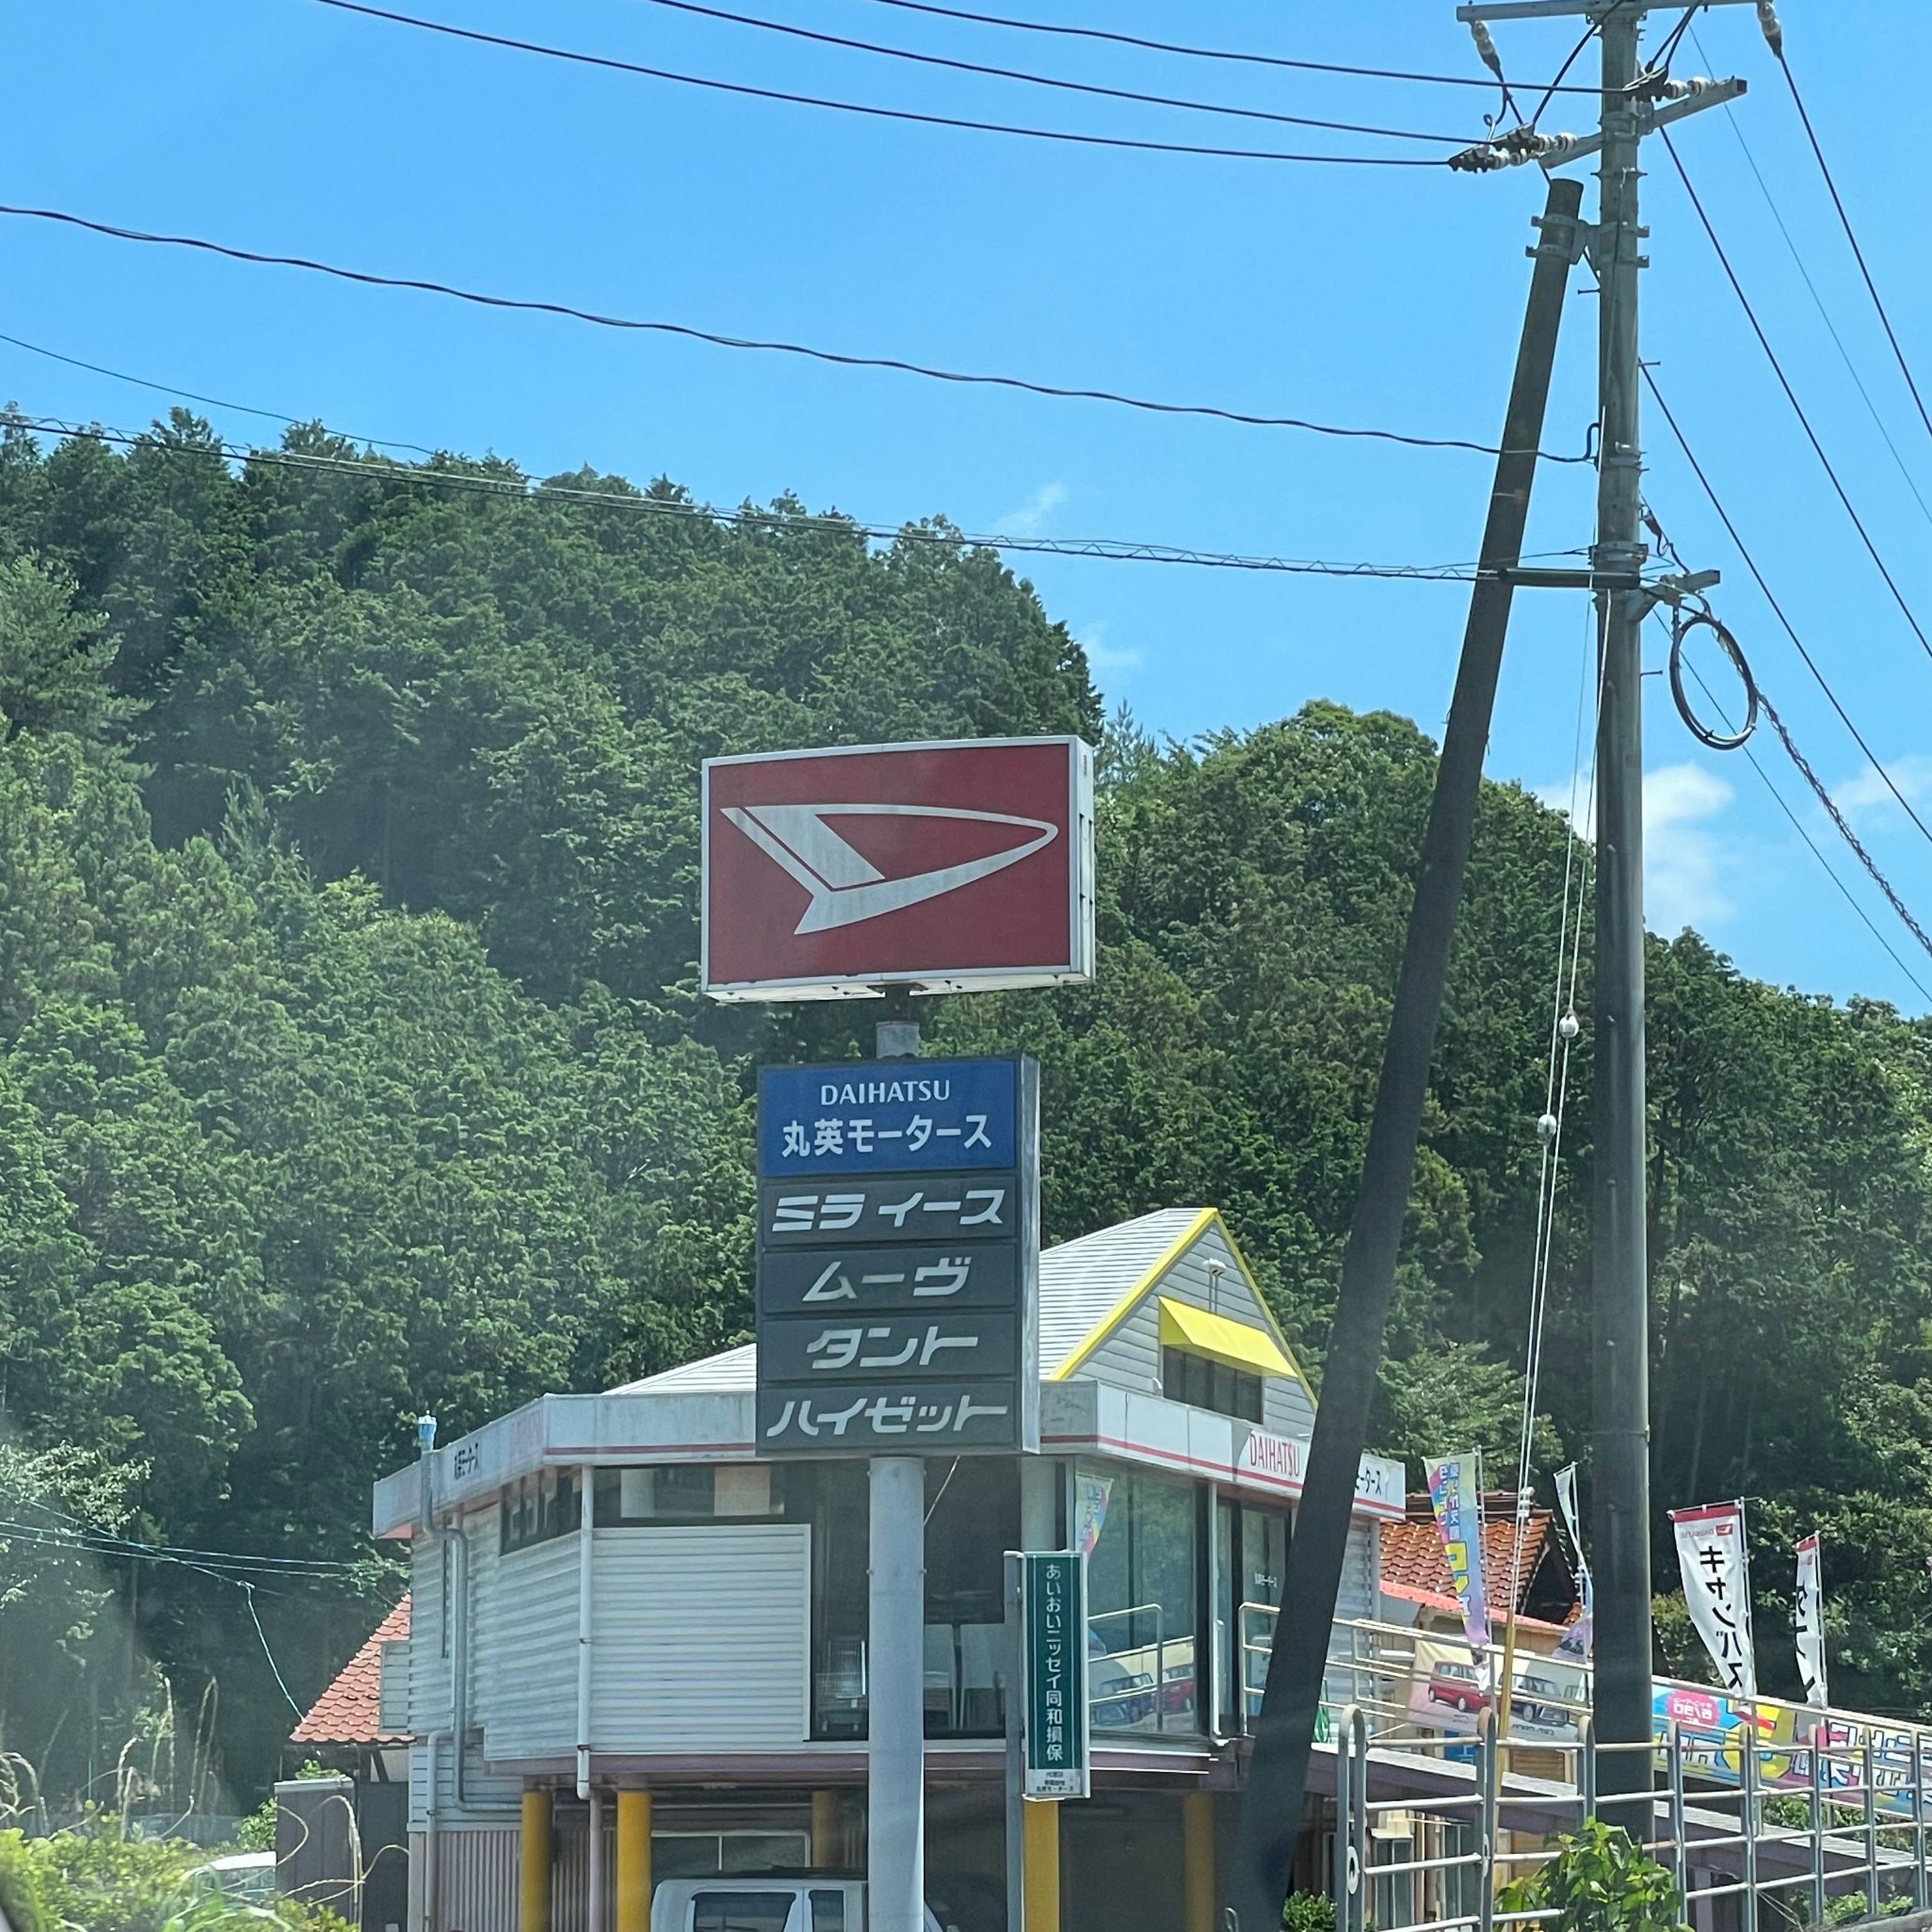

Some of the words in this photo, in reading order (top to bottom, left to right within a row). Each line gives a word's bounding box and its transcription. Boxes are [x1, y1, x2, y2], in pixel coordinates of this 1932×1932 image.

[821, 1080, 950, 1106] DAIHATSU
[782, 1114, 992, 1158] 丸英モータース
[802, 1256, 972, 1302] ムーヴ
[806, 1326, 978, 1369] タント
[767, 1395, 1008, 1438] ハイゼット
[1250, 1433, 1300, 1477] DAIHATSU
[1045, 1564, 1063, 1761] あいおいニッセイ同和損保
